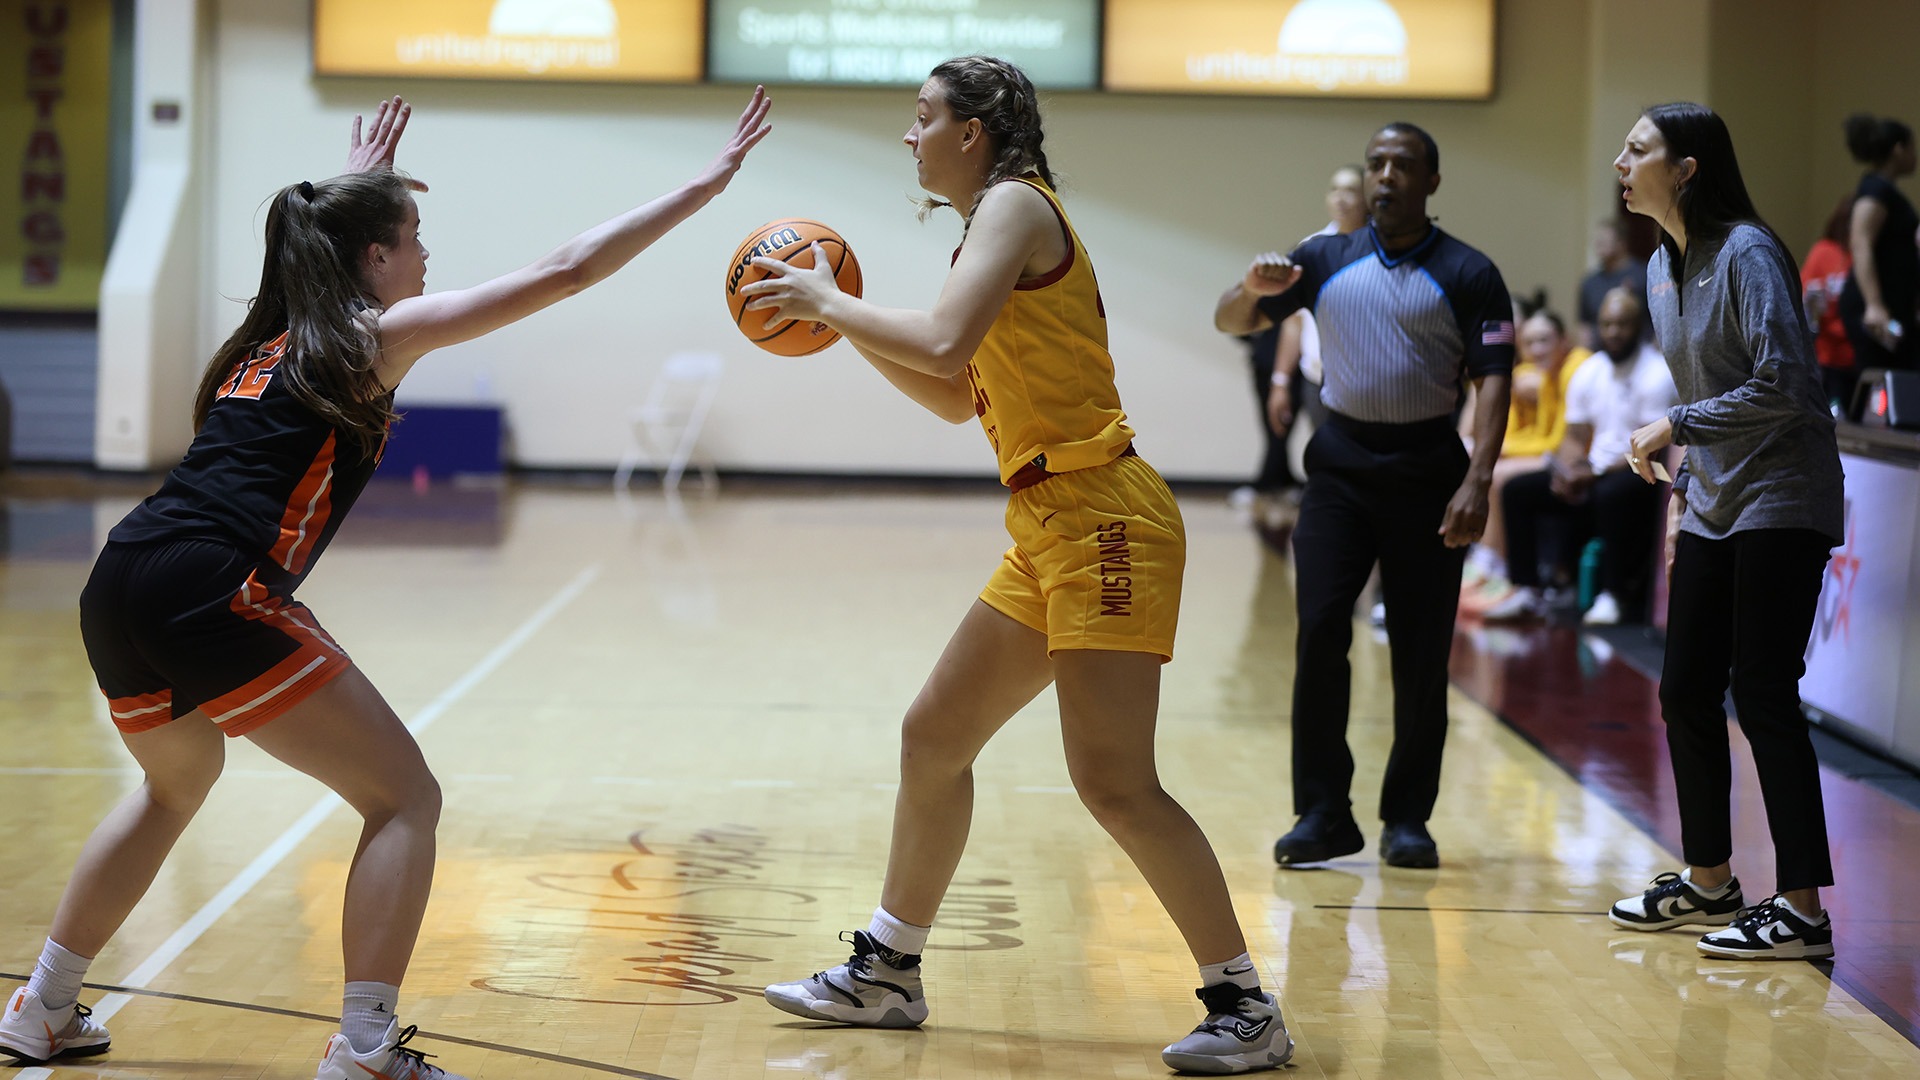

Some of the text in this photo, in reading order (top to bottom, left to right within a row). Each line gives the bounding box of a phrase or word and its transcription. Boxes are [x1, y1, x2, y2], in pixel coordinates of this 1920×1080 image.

[739, 8, 826, 47] Sports
[728, 227, 803, 296] Wilson
[1097, 521, 1132, 617] MUSTANGS
